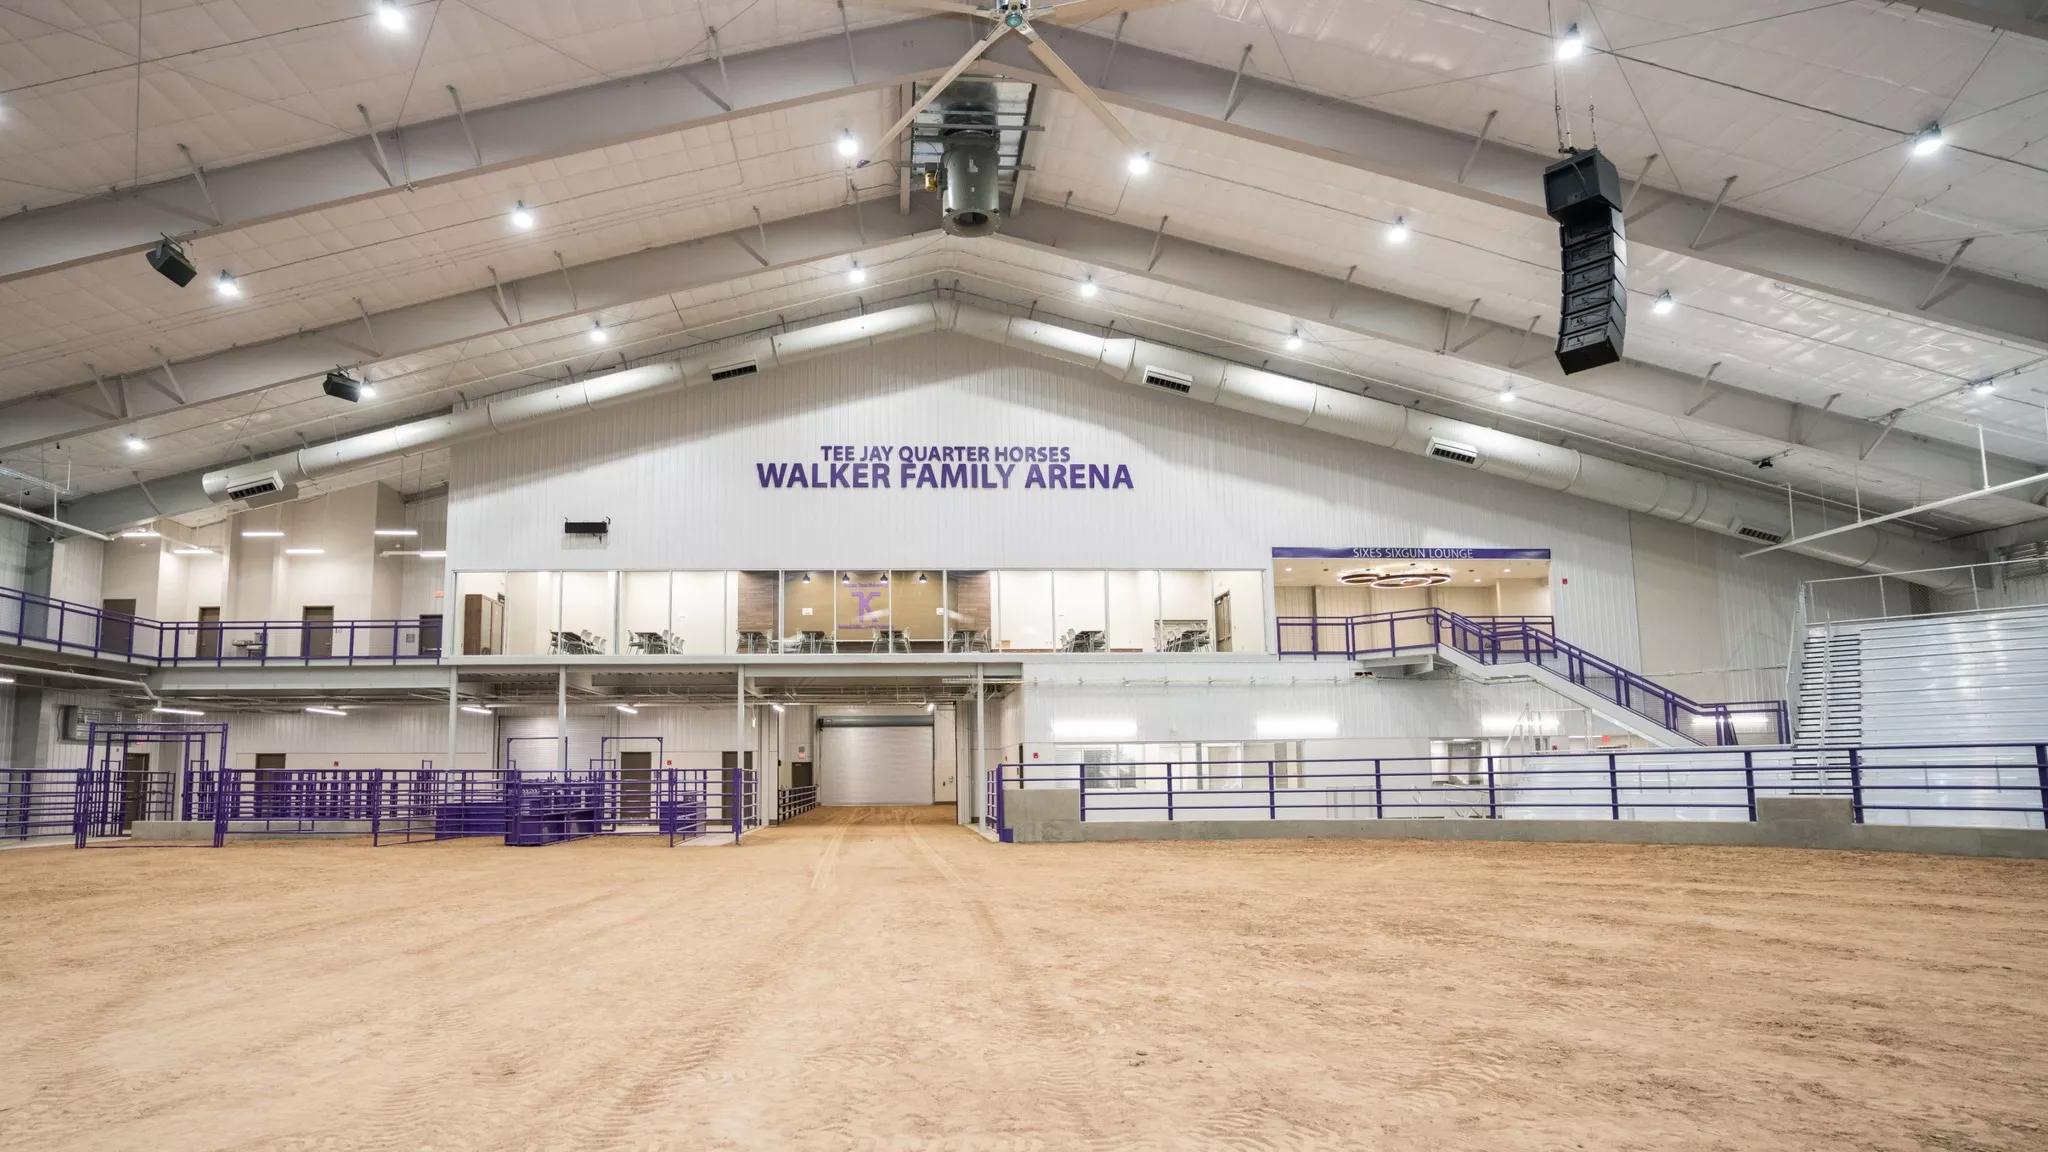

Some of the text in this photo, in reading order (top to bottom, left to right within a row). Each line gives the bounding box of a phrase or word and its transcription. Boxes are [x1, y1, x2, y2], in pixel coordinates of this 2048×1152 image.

[821, 445, 1071, 462] TEE JAY QUARTER HORSES
[757, 463, 1134, 489] WALKER FAMILY ARENA
[1353, 548, 1473, 558] SIXES SIXGUN LOUNGE
